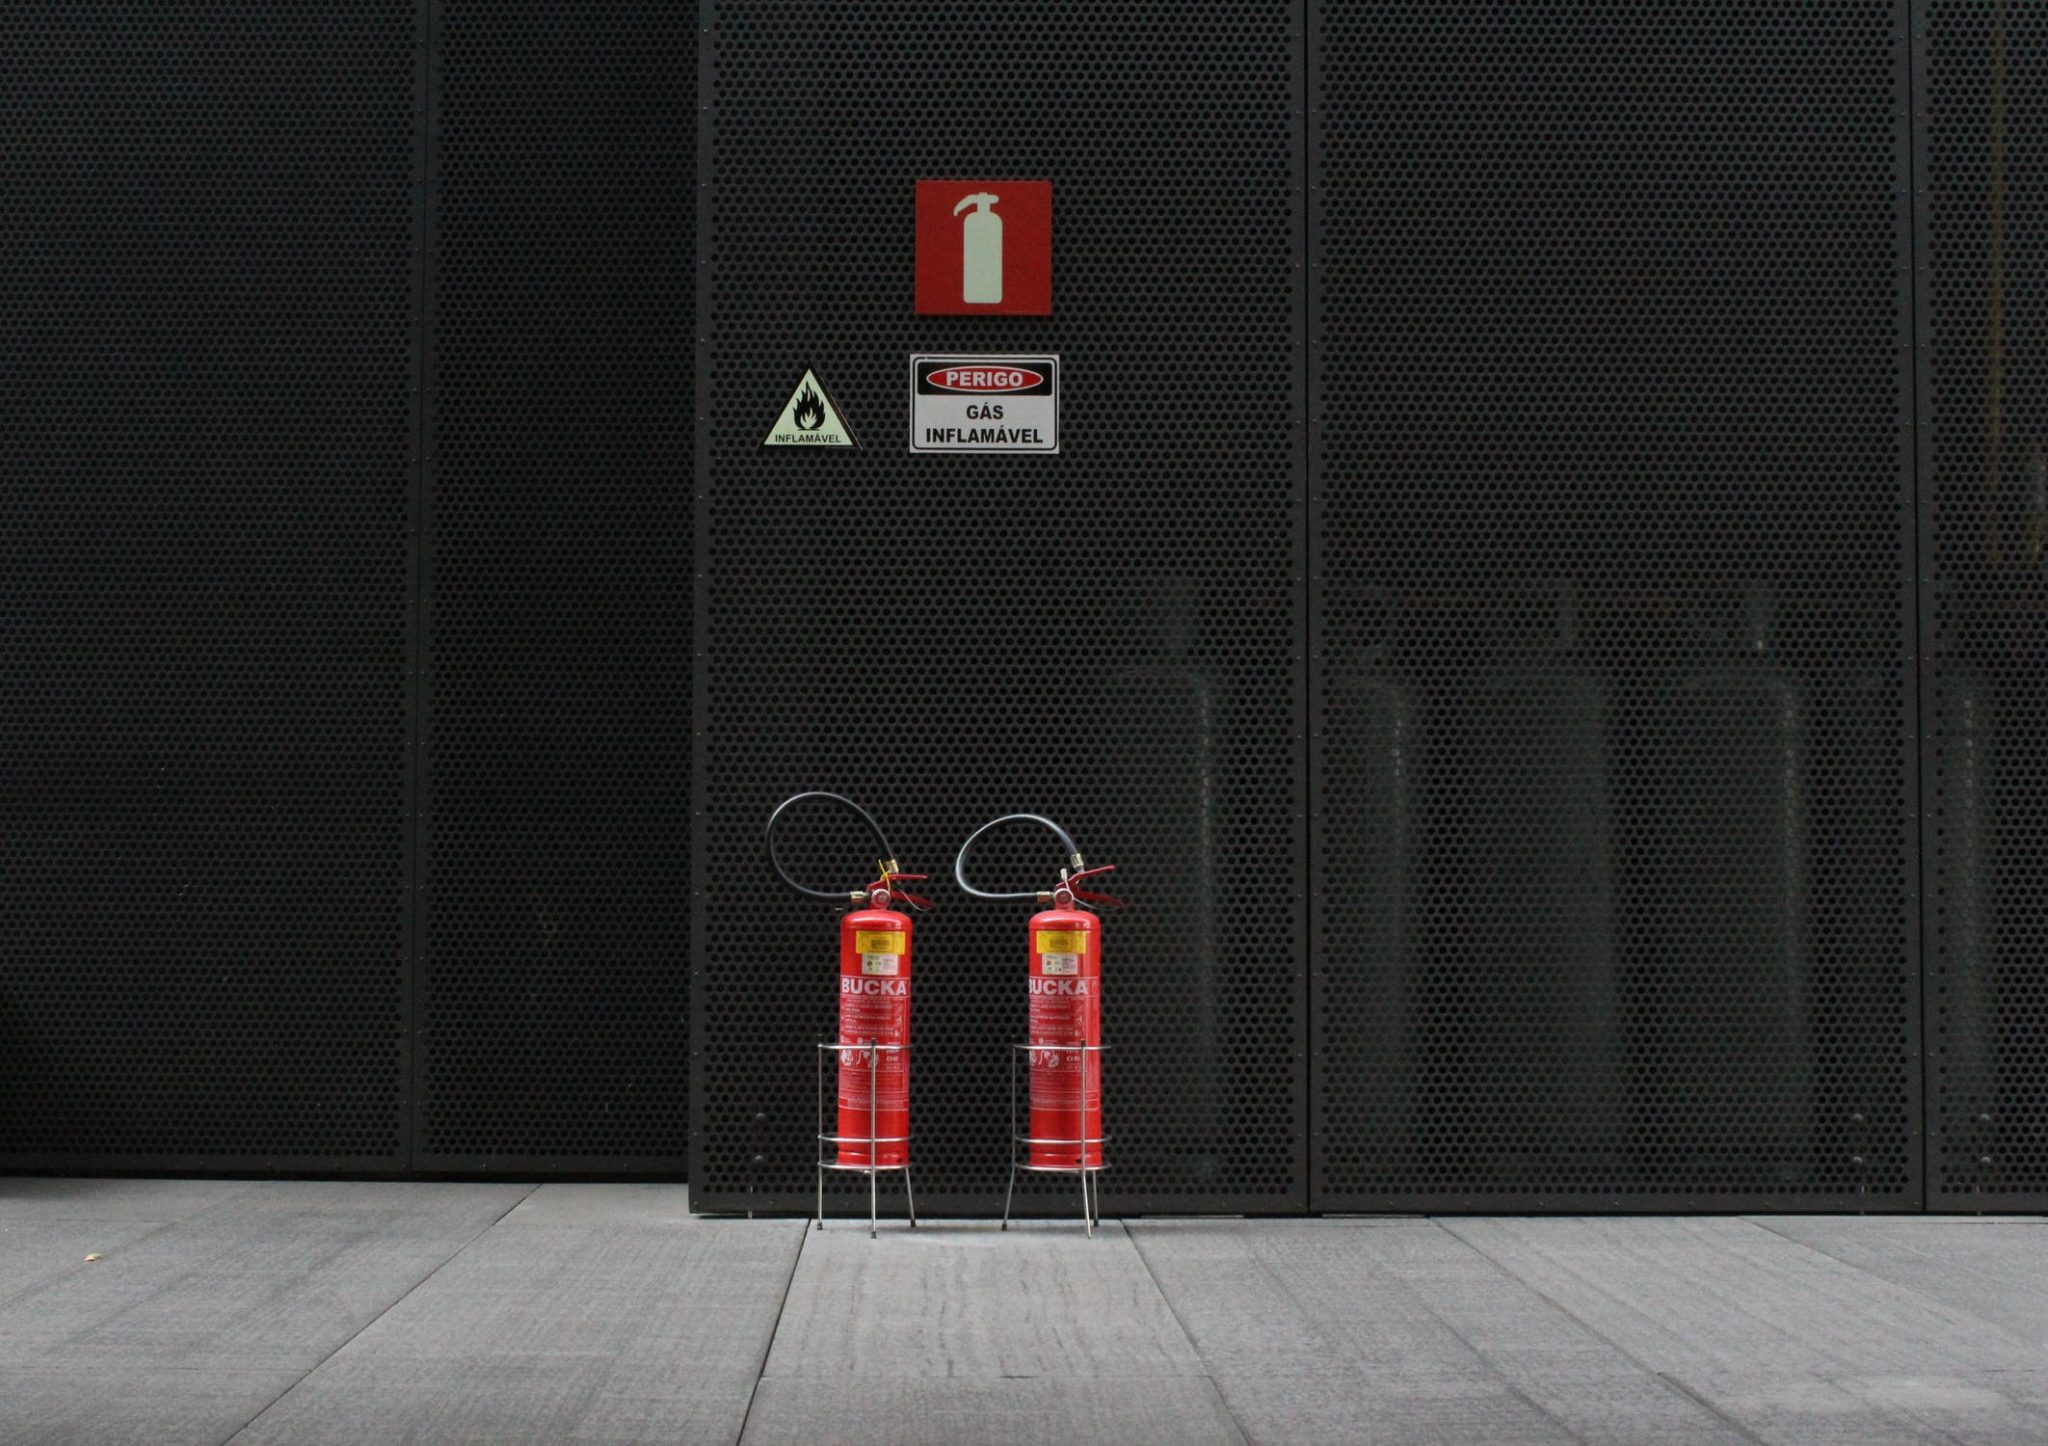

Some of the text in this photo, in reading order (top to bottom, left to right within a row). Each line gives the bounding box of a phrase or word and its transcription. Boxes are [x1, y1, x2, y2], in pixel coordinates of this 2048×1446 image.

[946, 371, 1024, 387] PERIGO
[966, 402, 1004, 420] GÁS
[775, 433, 842, 443] INFLAMÁVEL
[926, 425, 1043, 443] INFLAMÁVEL
[842, 977, 907, 996] BUCKA
